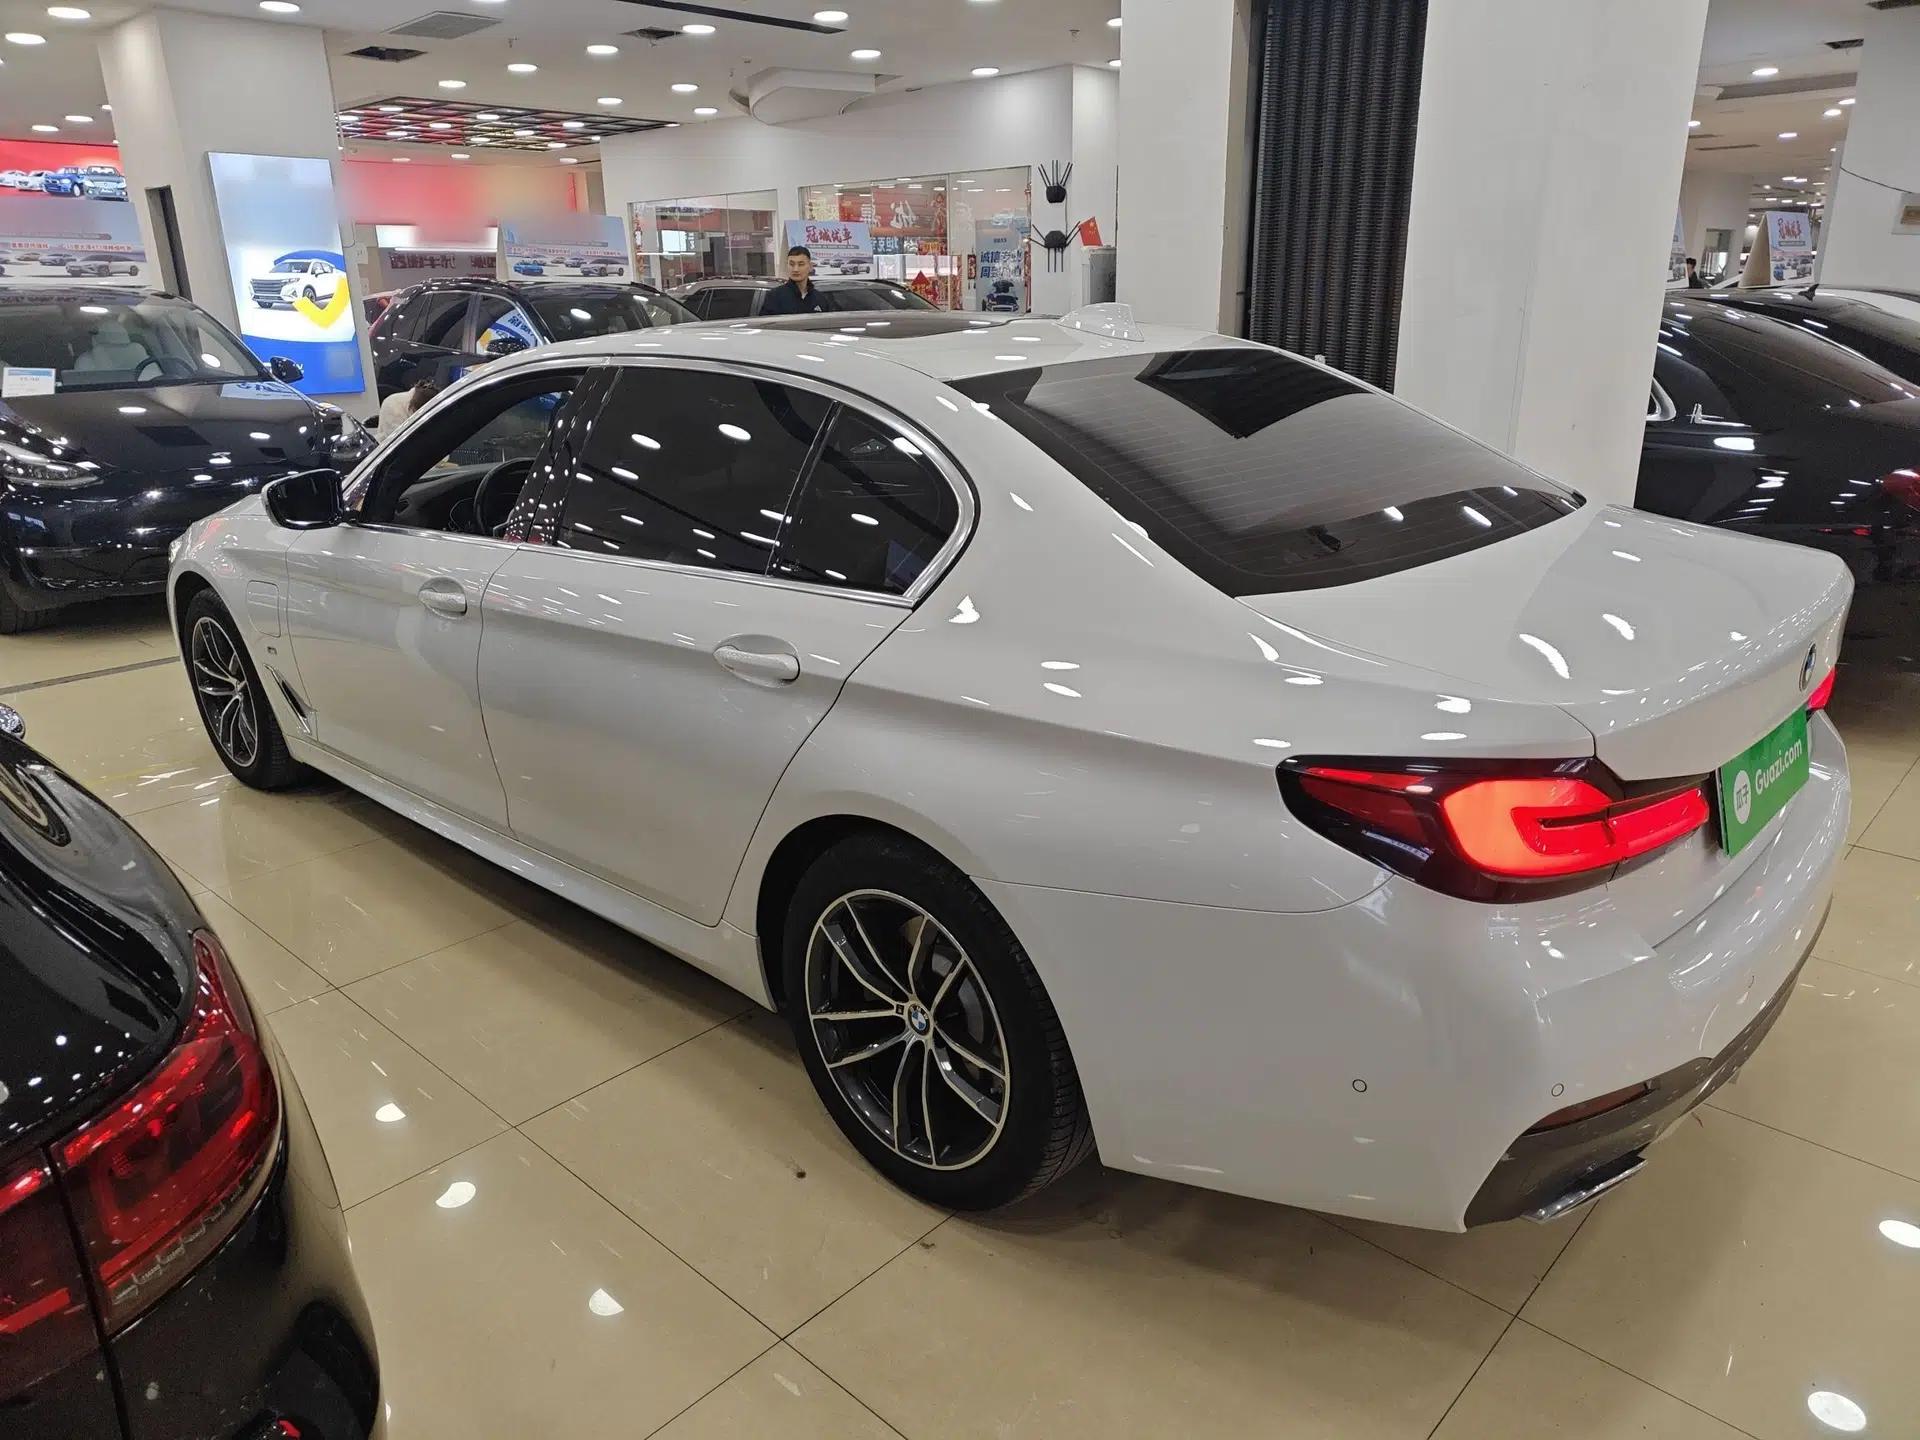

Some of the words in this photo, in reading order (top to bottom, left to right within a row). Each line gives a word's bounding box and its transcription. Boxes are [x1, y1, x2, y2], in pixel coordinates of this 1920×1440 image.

[805, 224, 852, 245] 冠城优车
[1755, 739, 1802, 795] Guazi.com
[1736, 783, 1749, 811] 瓜子
